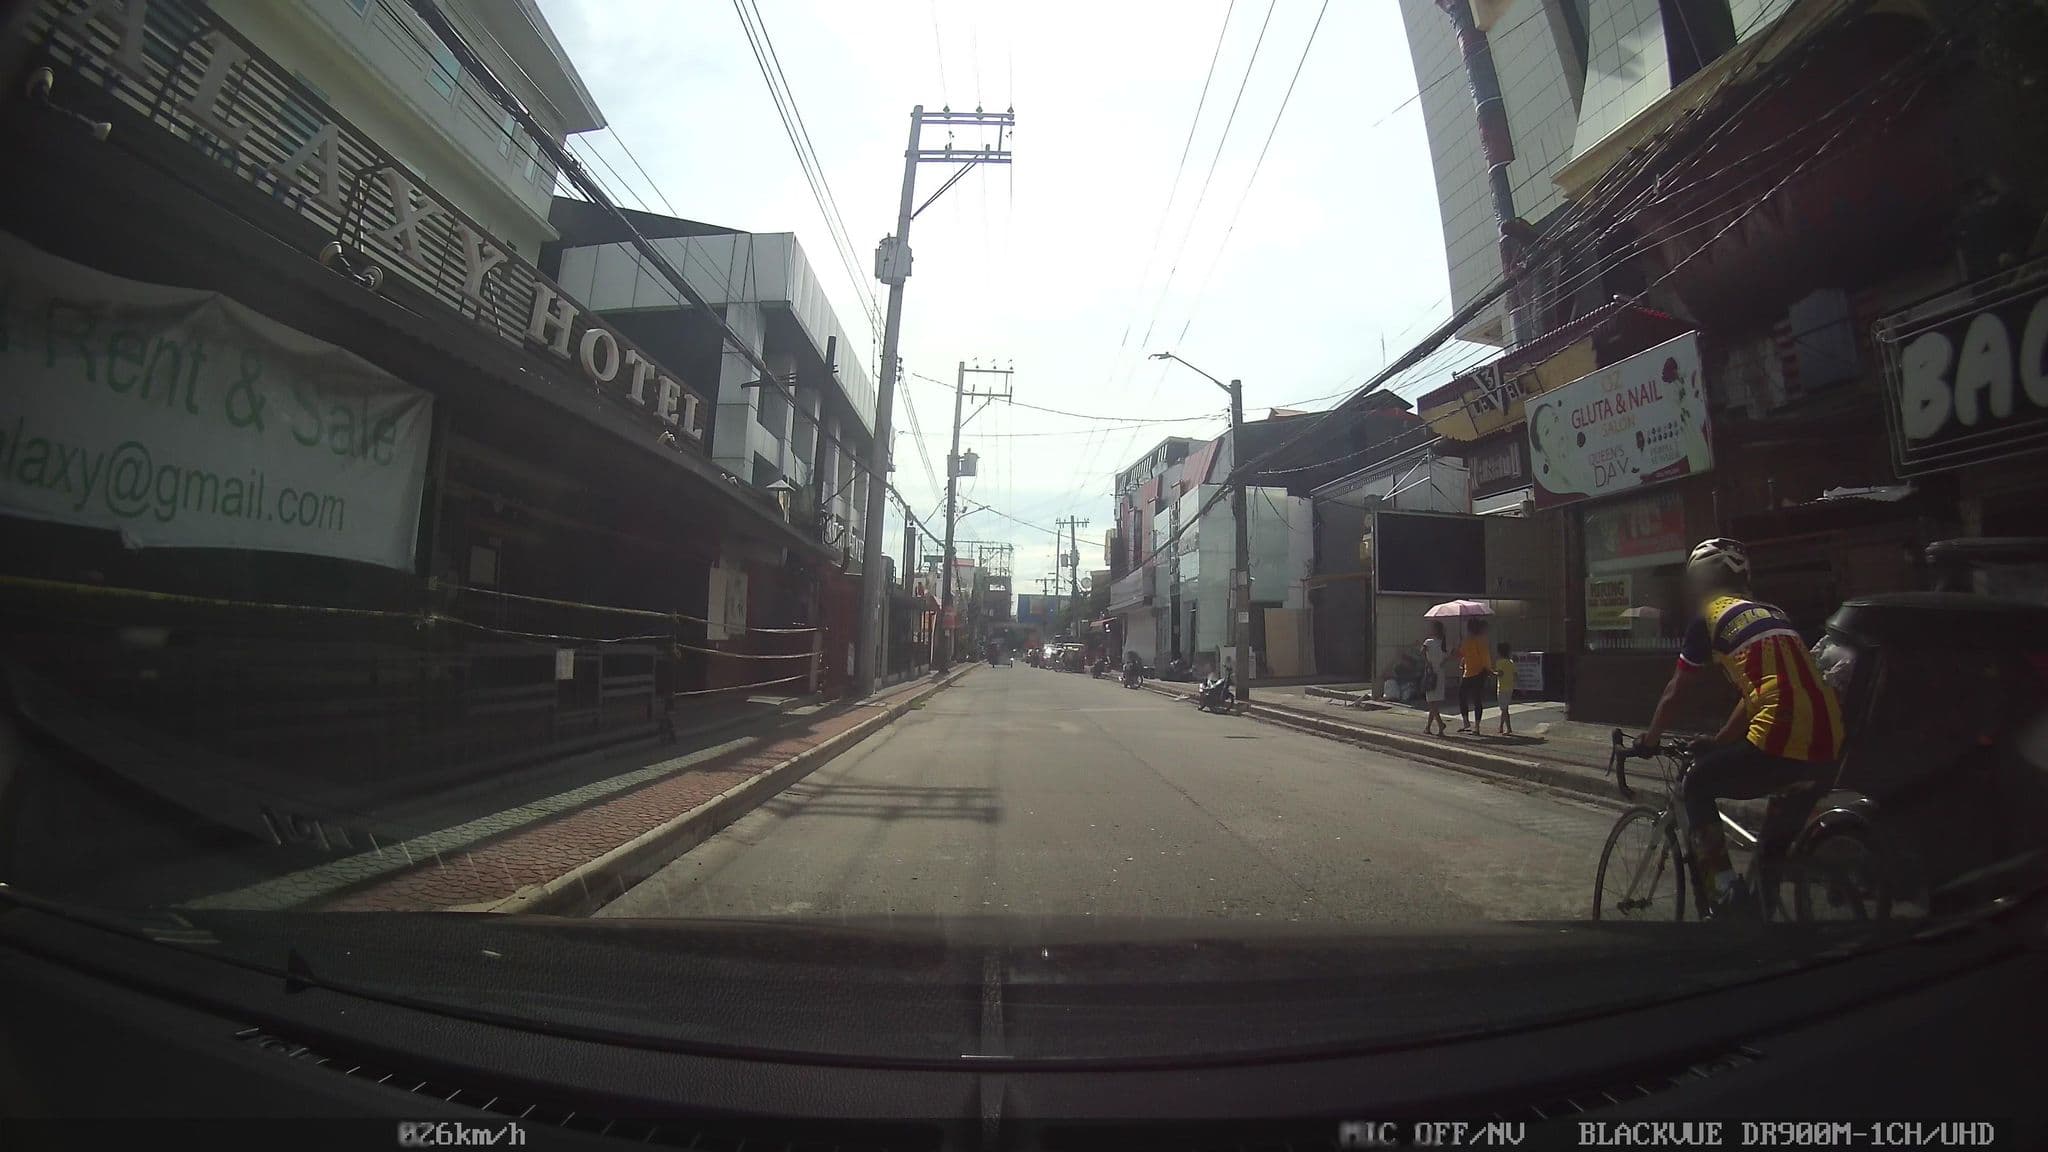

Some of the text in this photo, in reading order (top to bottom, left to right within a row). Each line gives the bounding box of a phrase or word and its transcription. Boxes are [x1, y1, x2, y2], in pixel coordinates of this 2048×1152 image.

[45, 298, 206, 416] Rent
[224, 347, 267, 433] &
[291, 380, 399, 468] Sale
[523, 281, 703, 441] HOTEL
[1571, 380, 1664, 430] GLUTA & NAIL
[1602, 414, 1637, 437] SALON
[0, 415, 345, 532] laxy@gmail.com
[1593, 456, 1630, 489] DAY
